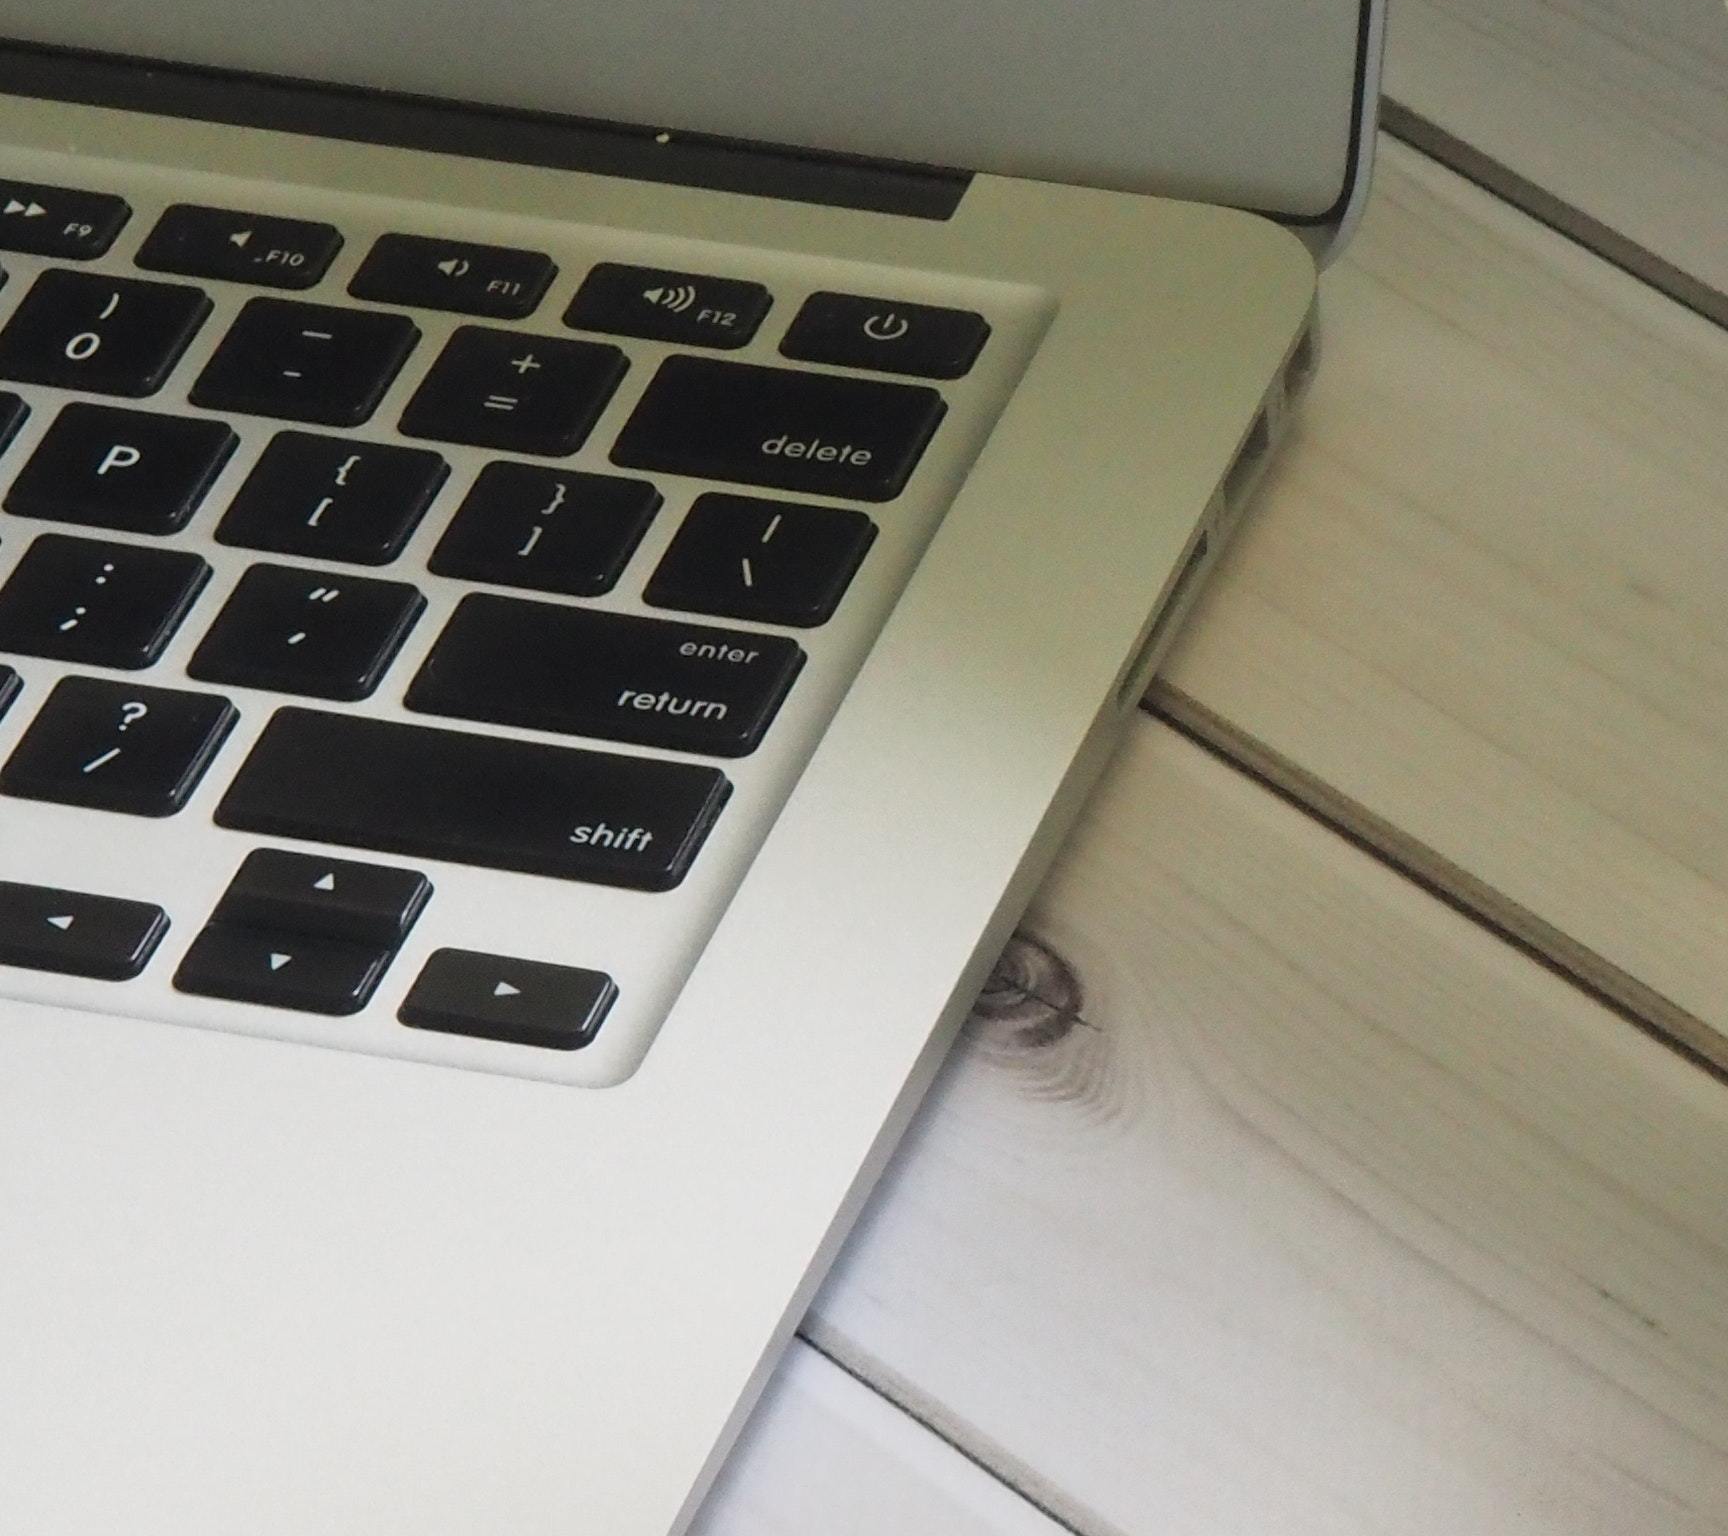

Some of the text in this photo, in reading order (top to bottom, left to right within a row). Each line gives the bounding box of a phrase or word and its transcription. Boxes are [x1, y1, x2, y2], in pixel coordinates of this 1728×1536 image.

[63, 222, 93, 238] F9
[265, 249, 305, 267] F10
[486, 280, 521, 296] F11
[697, 309, 737, 327] F12
[97, 445, 141, 475] P
[761, 434, 872, 466] delete
[679, 641, 759, 664] enter
[118, 701, 148, 731] ?
[617, 690, 728, 720] return
[569, 823, 653, 852] shift
